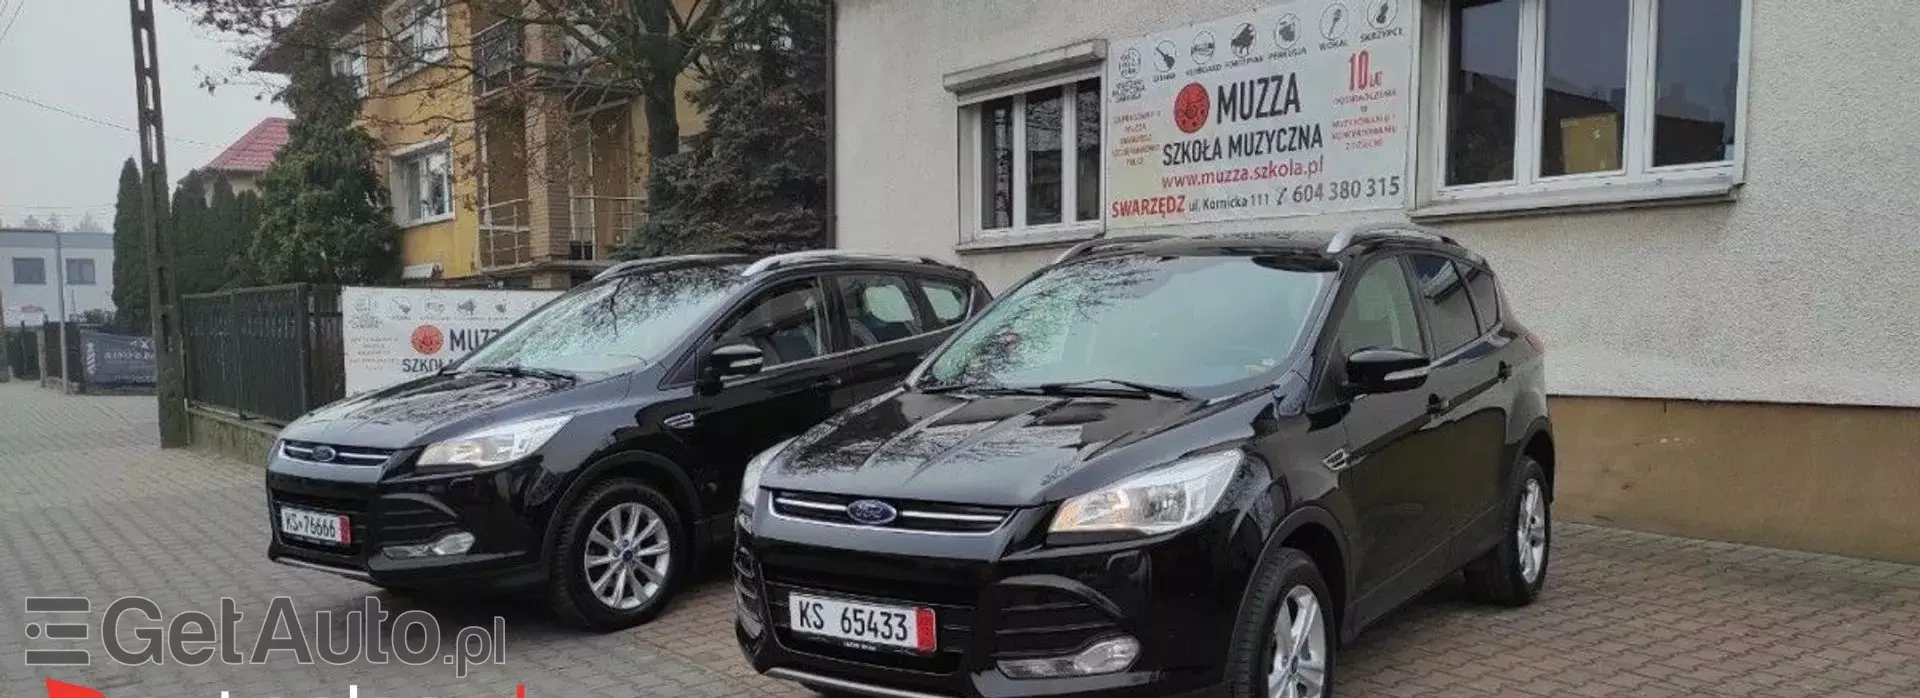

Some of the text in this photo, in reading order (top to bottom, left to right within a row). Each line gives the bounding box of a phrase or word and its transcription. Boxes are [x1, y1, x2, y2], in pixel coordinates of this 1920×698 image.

[1348, 50, 1370, 91] 10
[1217, 71, 1301, 125] MUZZA
[1163, 136, 1222, 167] SZKOŁA
[1228, 123, 1324, 159] MUZYCZNA
[1162, 154, 1324, 189] www.muzza.szkola.pl
[1111, 195, 1186, 218] SWARZĘDZ
[1251, 193, 1269, 206] 111
[1292, 182, 1324, 203] 604
[1328, 180, 1362, 201] 380
[1366, 176, 1400, 197] 315
[799, 600, 908, 641] KS 65433
